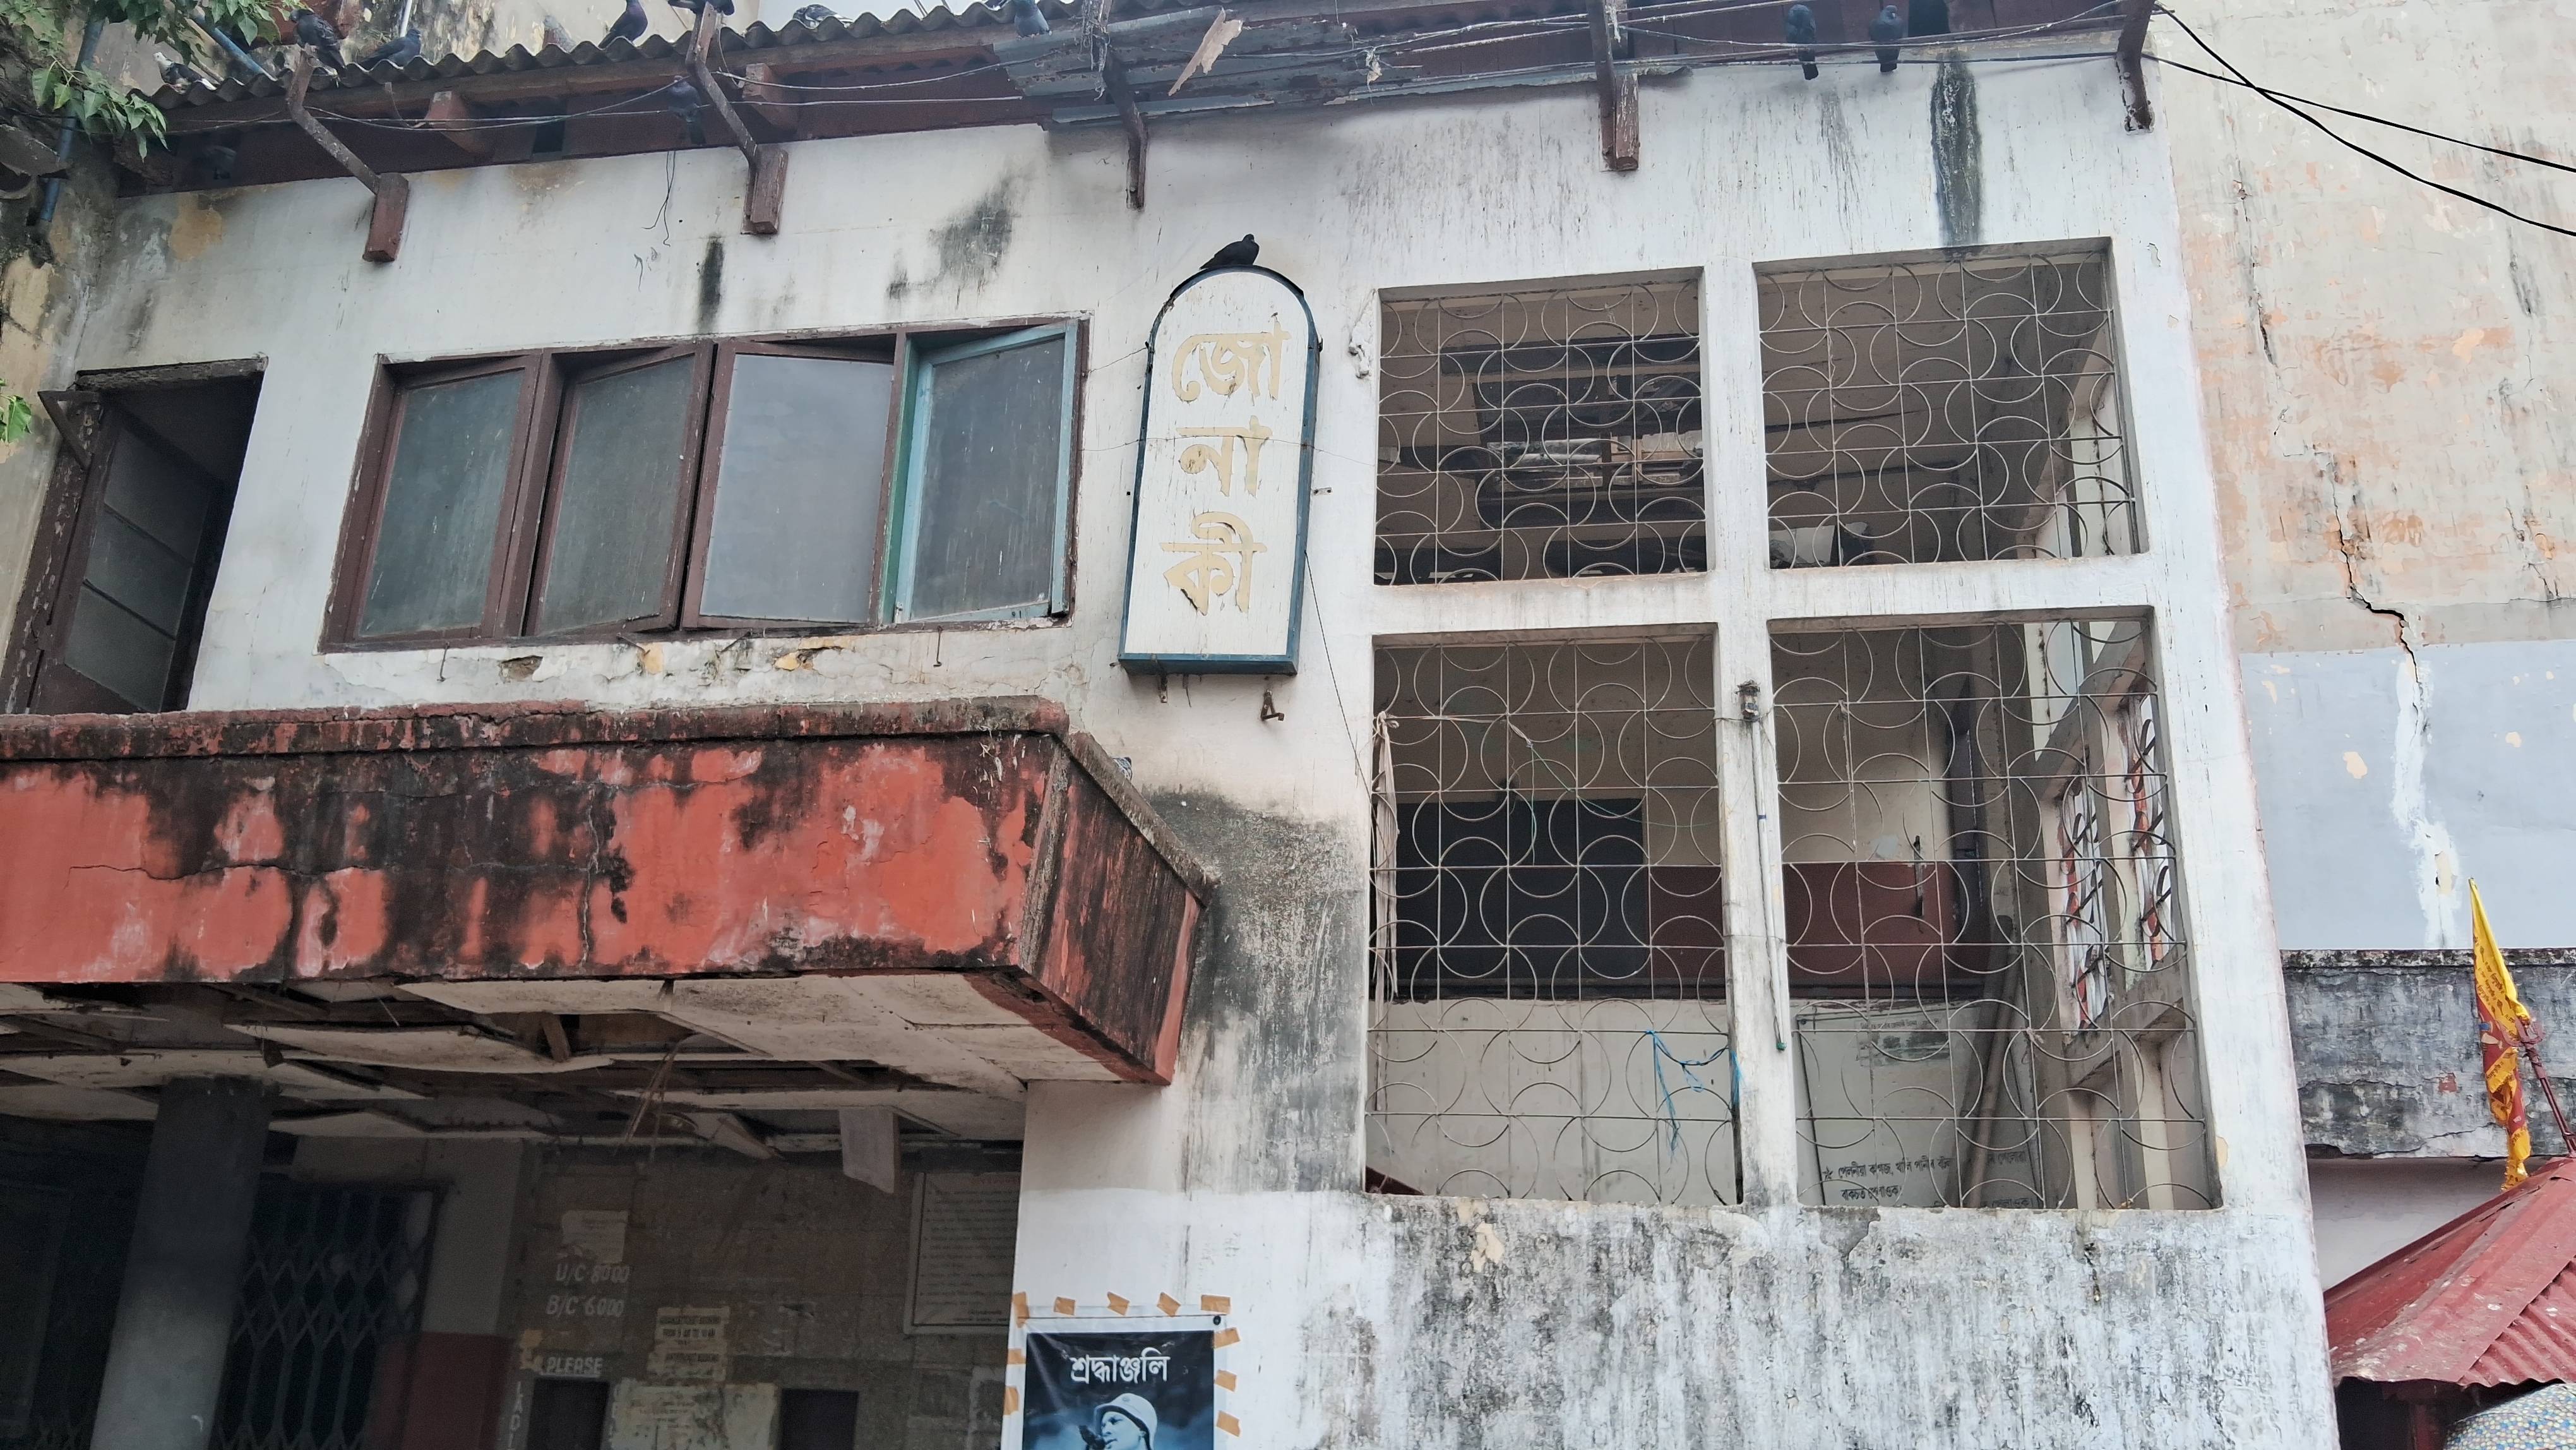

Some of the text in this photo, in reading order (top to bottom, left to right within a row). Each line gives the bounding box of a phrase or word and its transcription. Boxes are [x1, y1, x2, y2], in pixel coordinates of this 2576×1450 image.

[546, 1356, 604, 1375] PLEASE
[1070, 1346, 1171, 1384] শ্রদ্ধাঞ্জলি
[506, 1381, 524, 1450] LADI
